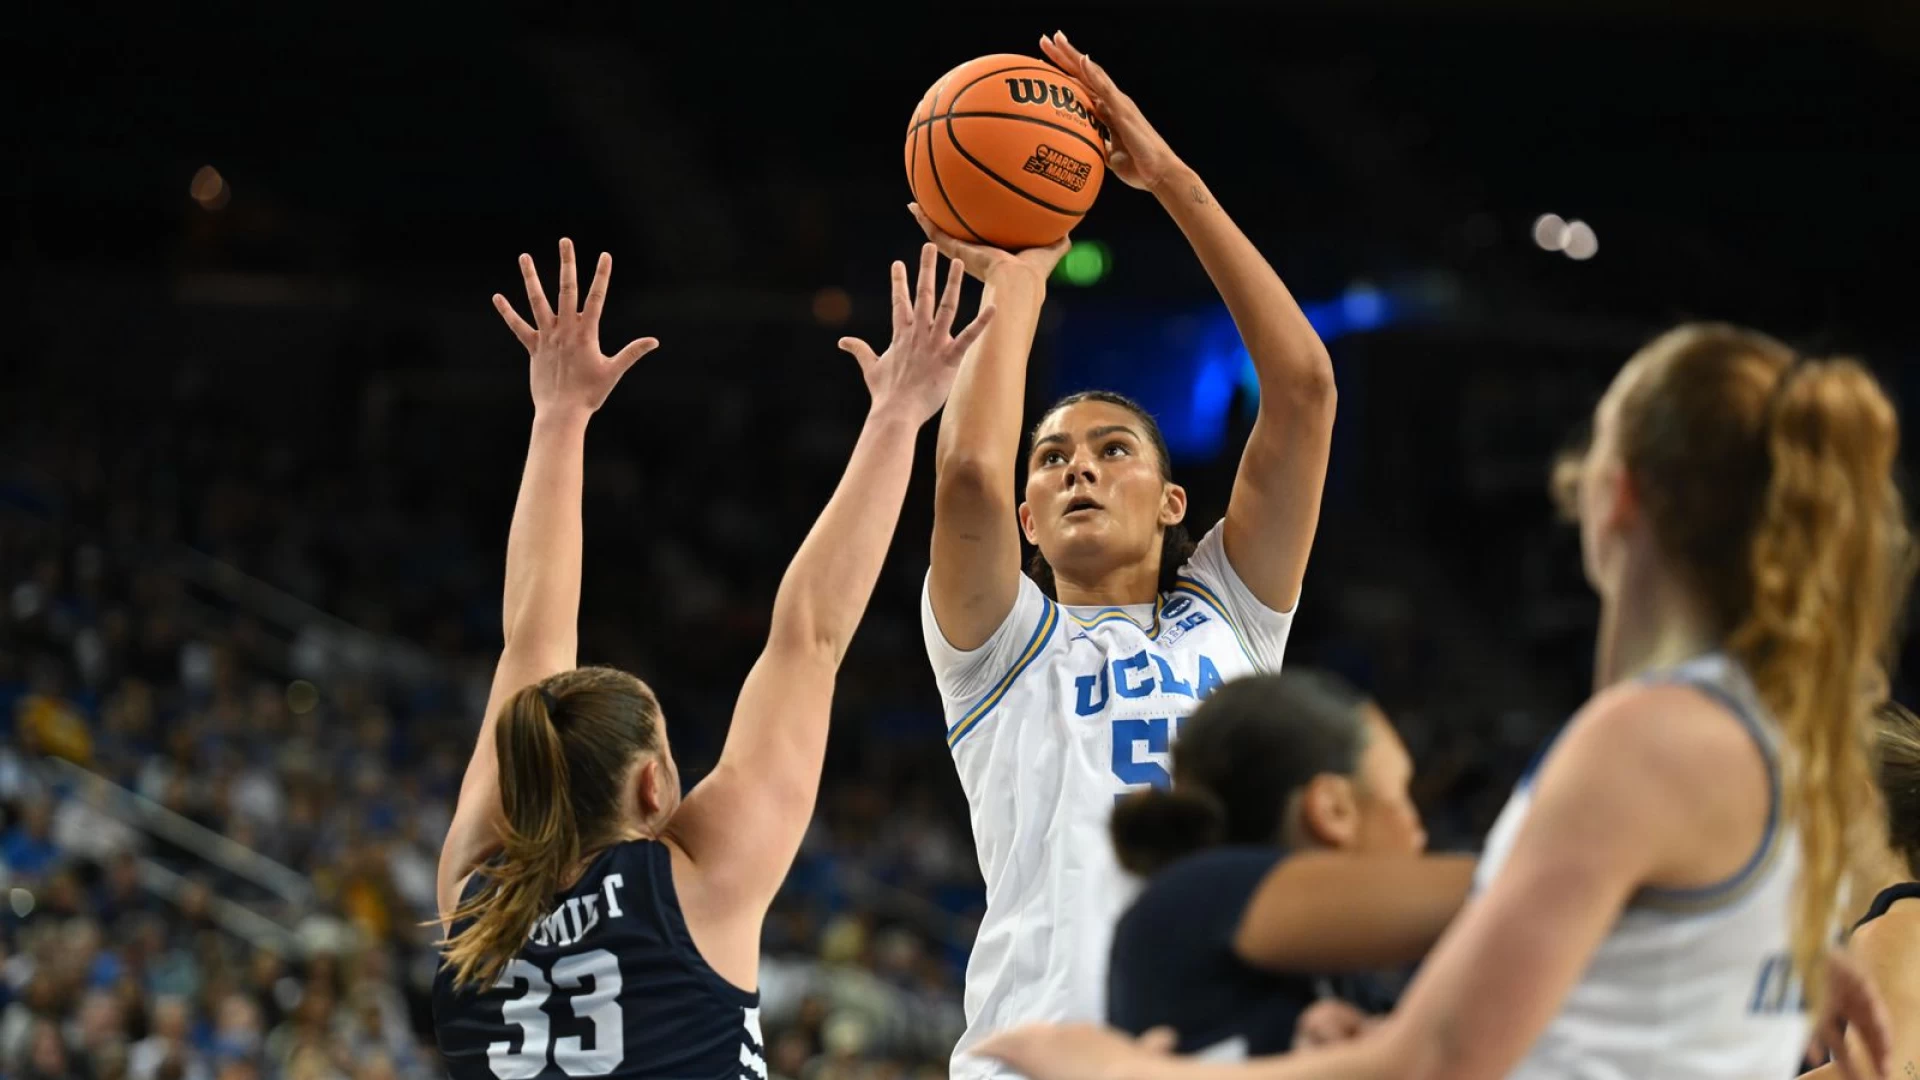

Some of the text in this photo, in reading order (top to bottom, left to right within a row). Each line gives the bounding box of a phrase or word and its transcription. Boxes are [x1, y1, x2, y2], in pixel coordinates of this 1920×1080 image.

[1044, 162, 1087, 189] MADNESS
[1045, 149, 1081, 174] MARCH
[1075, 649, 1227, 717] UCLA
[1111, 717, 1190, 808] 5
[486, 948, 624, 1080] 33
